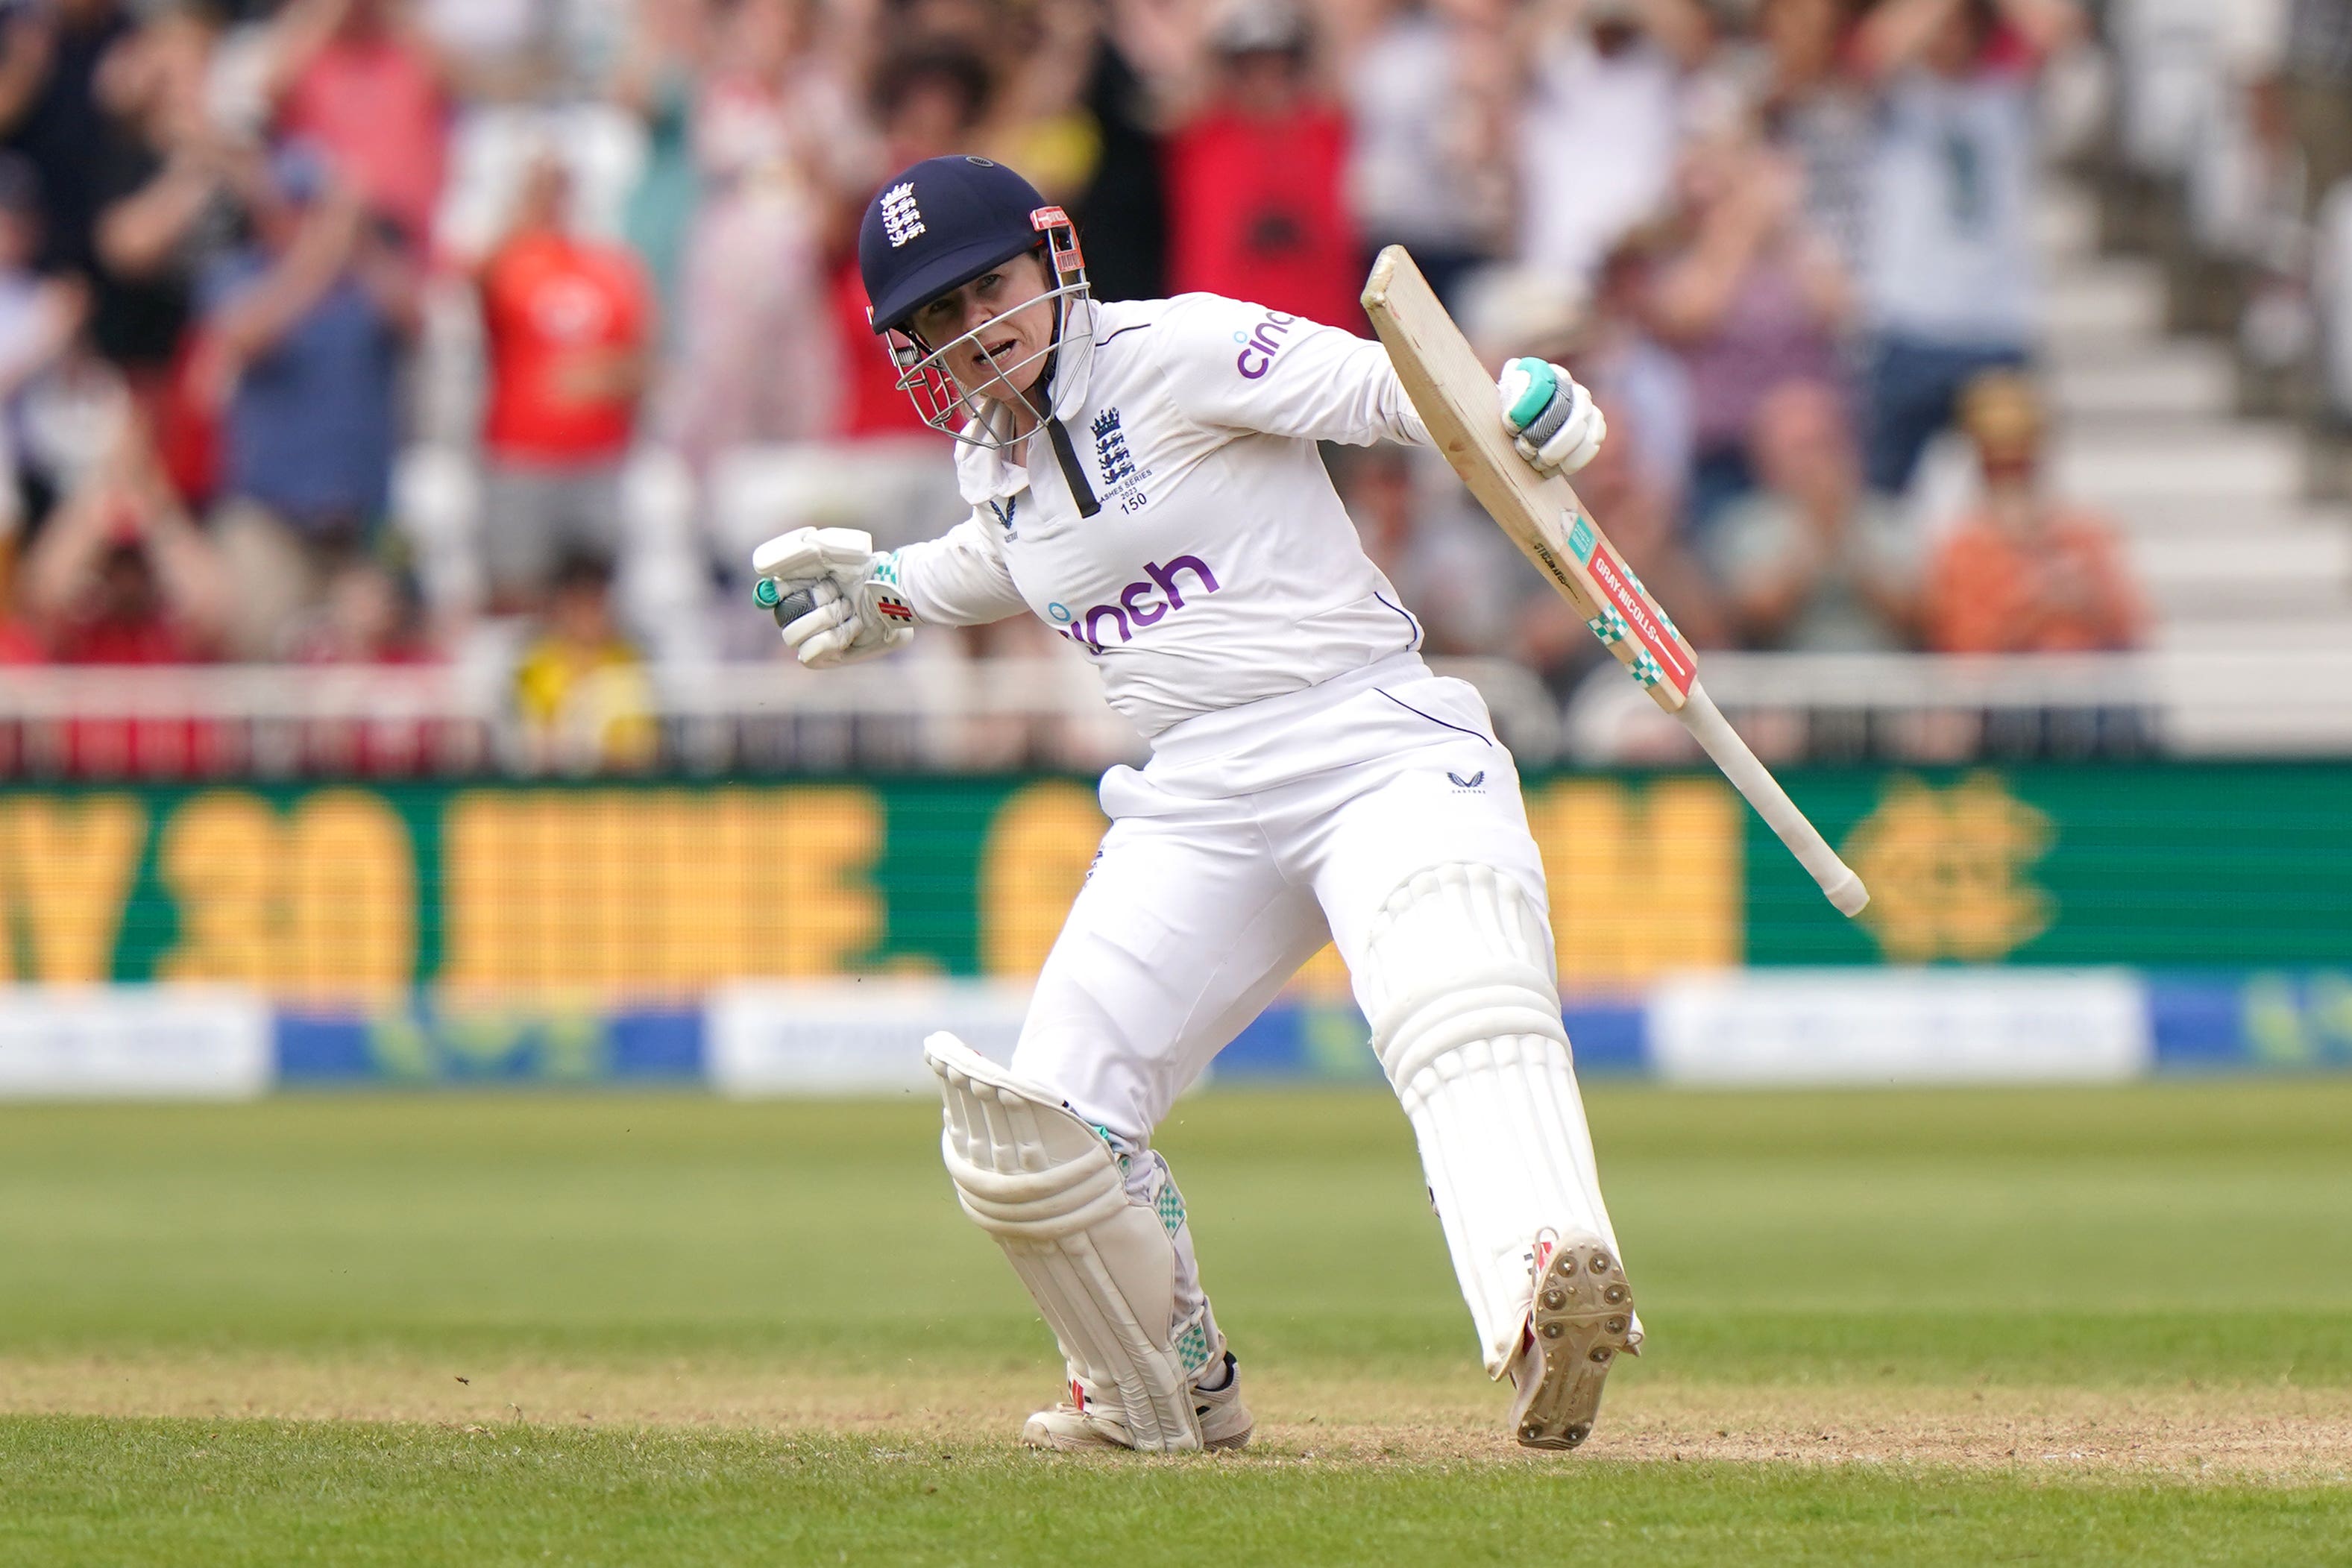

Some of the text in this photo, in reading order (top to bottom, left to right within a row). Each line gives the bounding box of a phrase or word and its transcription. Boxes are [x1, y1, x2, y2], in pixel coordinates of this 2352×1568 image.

[1234, 312, 1295, 379] cinc
[1100, 469, 1153, 503] ASHES SERIES
[1121, 487, 1138, 500] 2023
[1121, 493, 1147, 514] 150
[1048, 555, 1220, 655] inch
[1595, 557, 1658, 641] GRAY-NICOLLS
